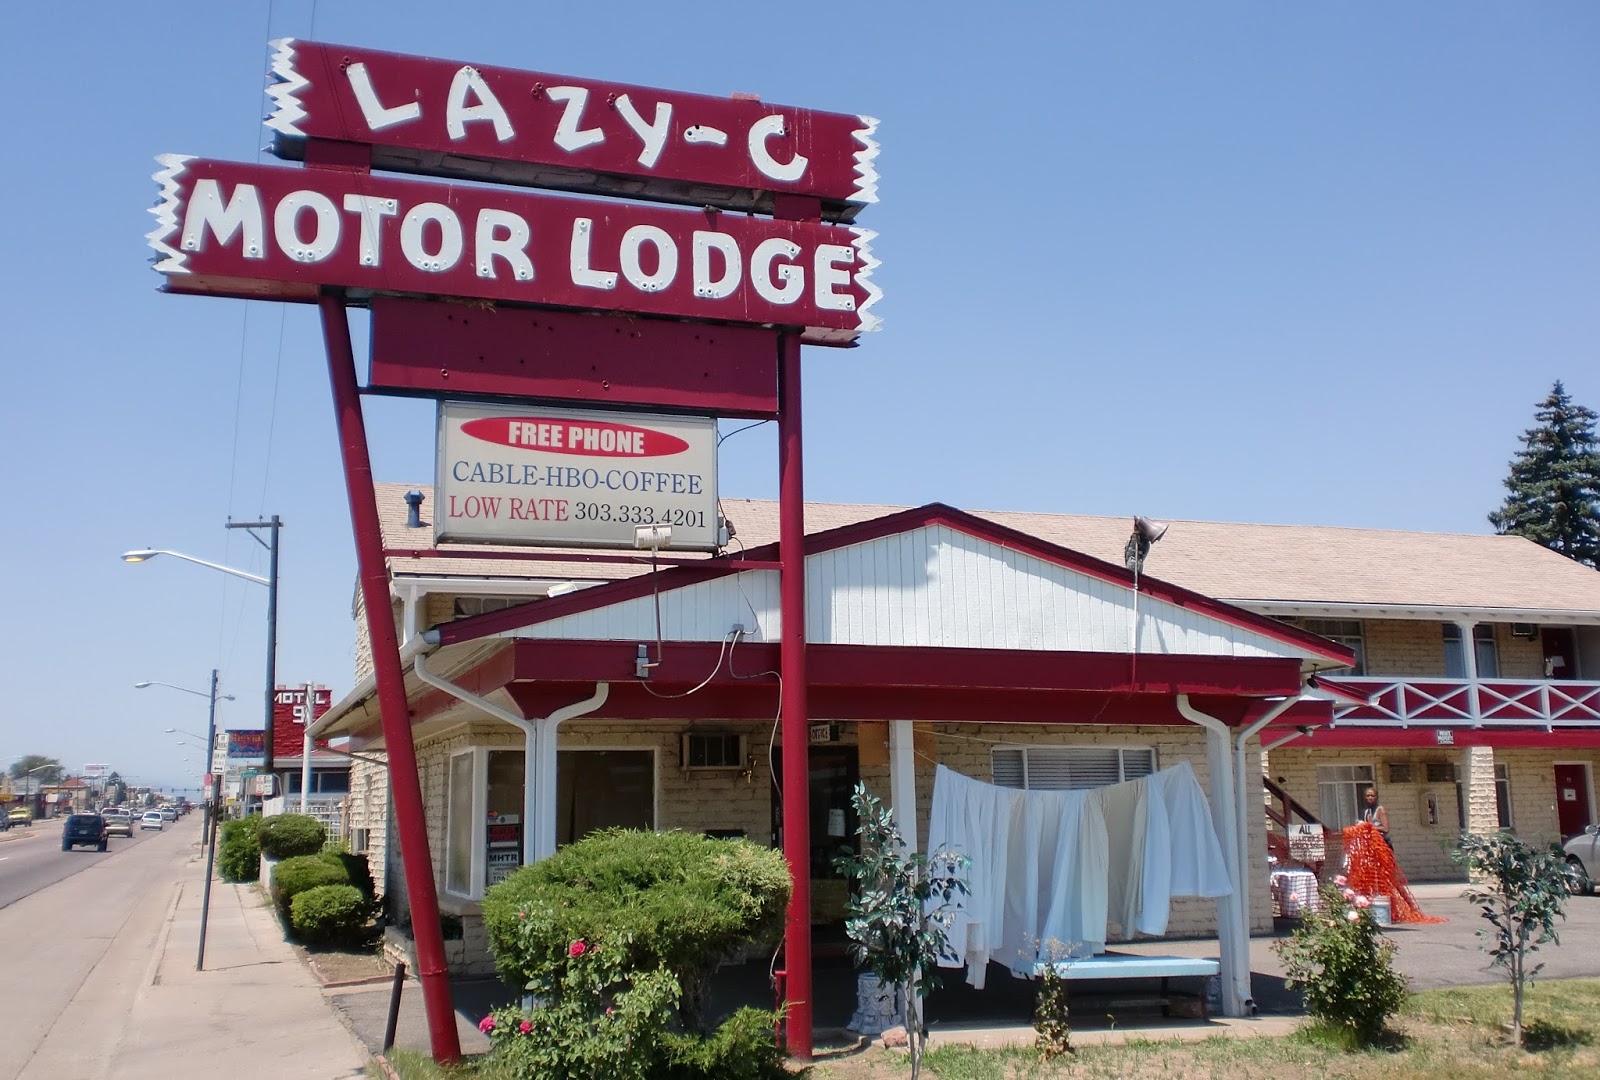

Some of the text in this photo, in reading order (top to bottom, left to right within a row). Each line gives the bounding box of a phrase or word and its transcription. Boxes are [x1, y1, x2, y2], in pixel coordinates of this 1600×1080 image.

[346, 62, 808, 181] LAZY-C
[180, 178, 856, 311] MOTOR LODGE
[508, 421, 645, 454] FREE PHONE
[452, 460, 703, 495] CABLE-HBO-COFFEE
[449, 495, 706, 528] LOW RATE 303.333.4201
[274, 692, 326, 704] MOTL
[1299, 825, 1312, 835] ALL
[488, 853, 518, 862] MHTR
